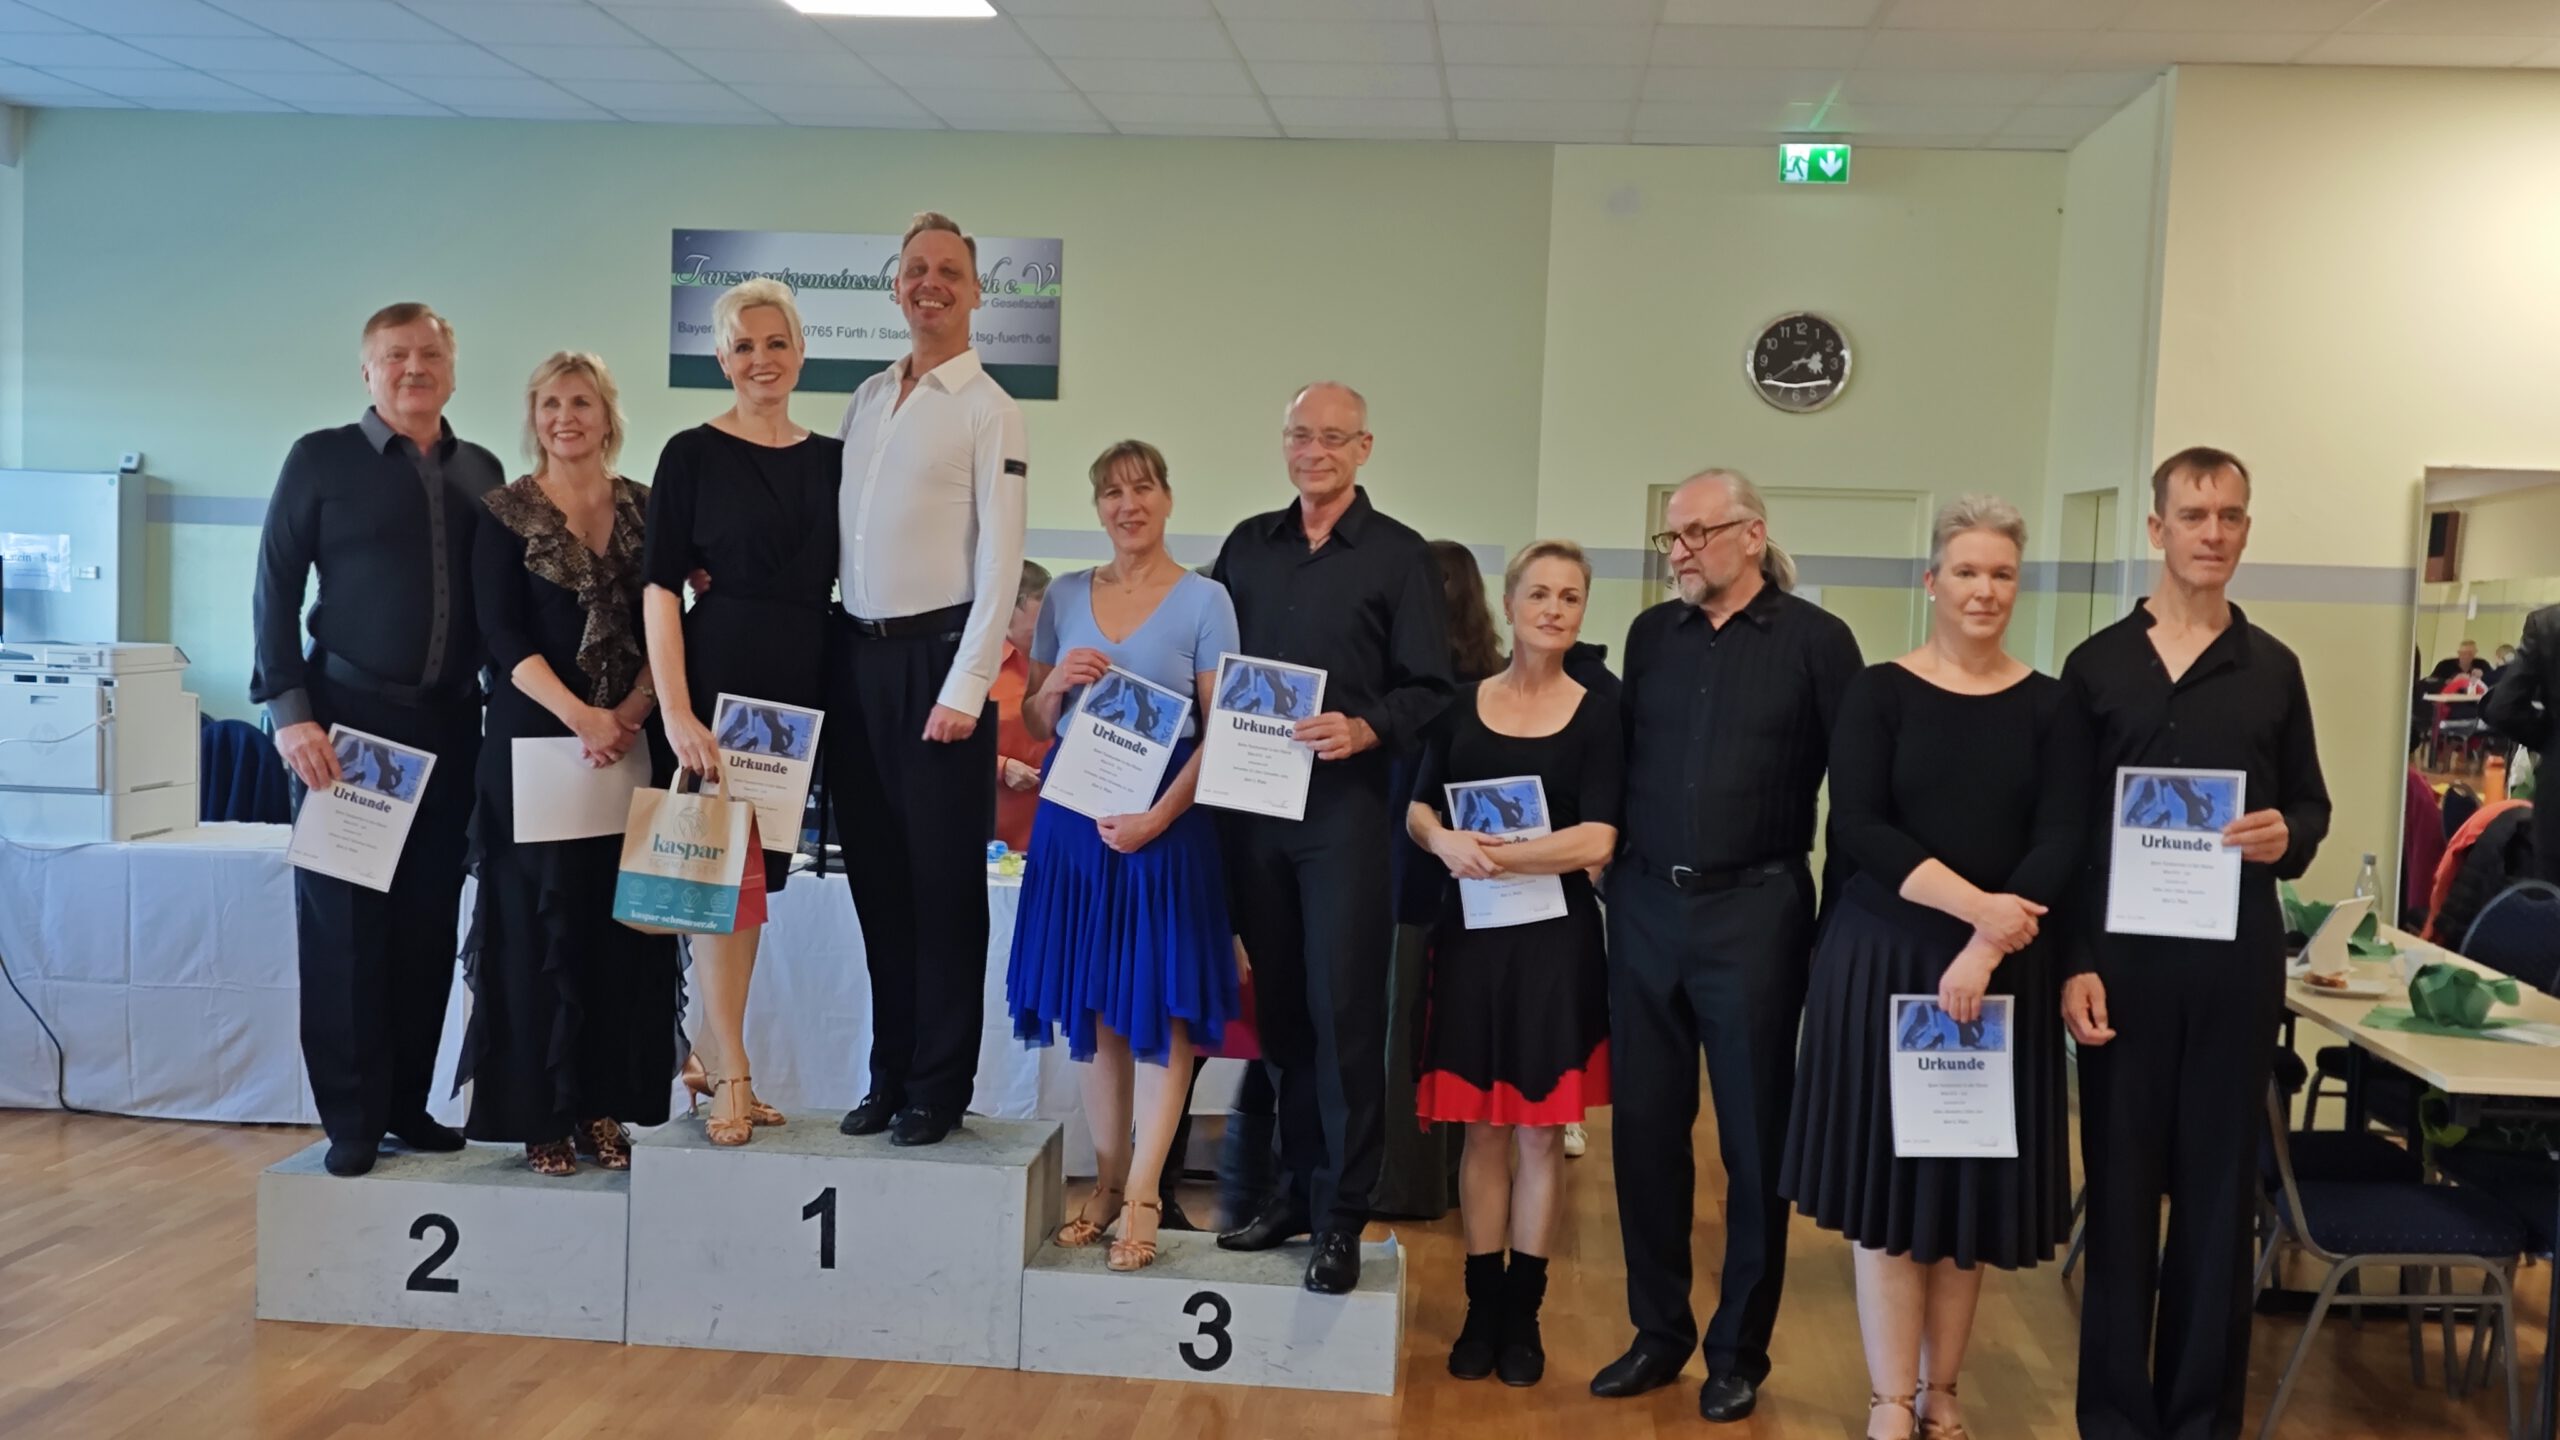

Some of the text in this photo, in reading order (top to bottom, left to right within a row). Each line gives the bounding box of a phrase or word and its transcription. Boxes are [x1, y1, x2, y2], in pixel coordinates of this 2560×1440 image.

[991, 298, 1055, 309] Gesellschaft
[678, 321, 715, 336] Bayer
[802, 325, 833, 338] 0765
[837, 325, 868, 338] Fürth
[969, 331, 1052, 345] .tsg-fuerth.de
[1780, 326, 1790, 338] 11
[1796, 322, 1808, 335] 12
[1815, 328, 1820, 339] 1
[1766, 338, 1778, 350] 10
[1825, 339, 1834, 352] 2
[1760, 354, 1768, 367] 9
[1830, 357, 1838, 370] 3
[1792, 388, 1800, 401] 6
[1233, 717, 1293, 738] Urkunde
[1093, 723, 1148, 757] Urkunde
[730, 756, 788, 775] Urkunde
[333, 786, 393, 813] Urkunde
[653, 833, 724, 860] kaspar
[2141, 834, 2212, 852] Urkunde
[1918, 1057, 1986, 1071] Urkunde
[802, 1187, 836, 1269] 1
[406, 1213, 460, 1294] 2
[1179, 1290, 1233, 1372] 3
